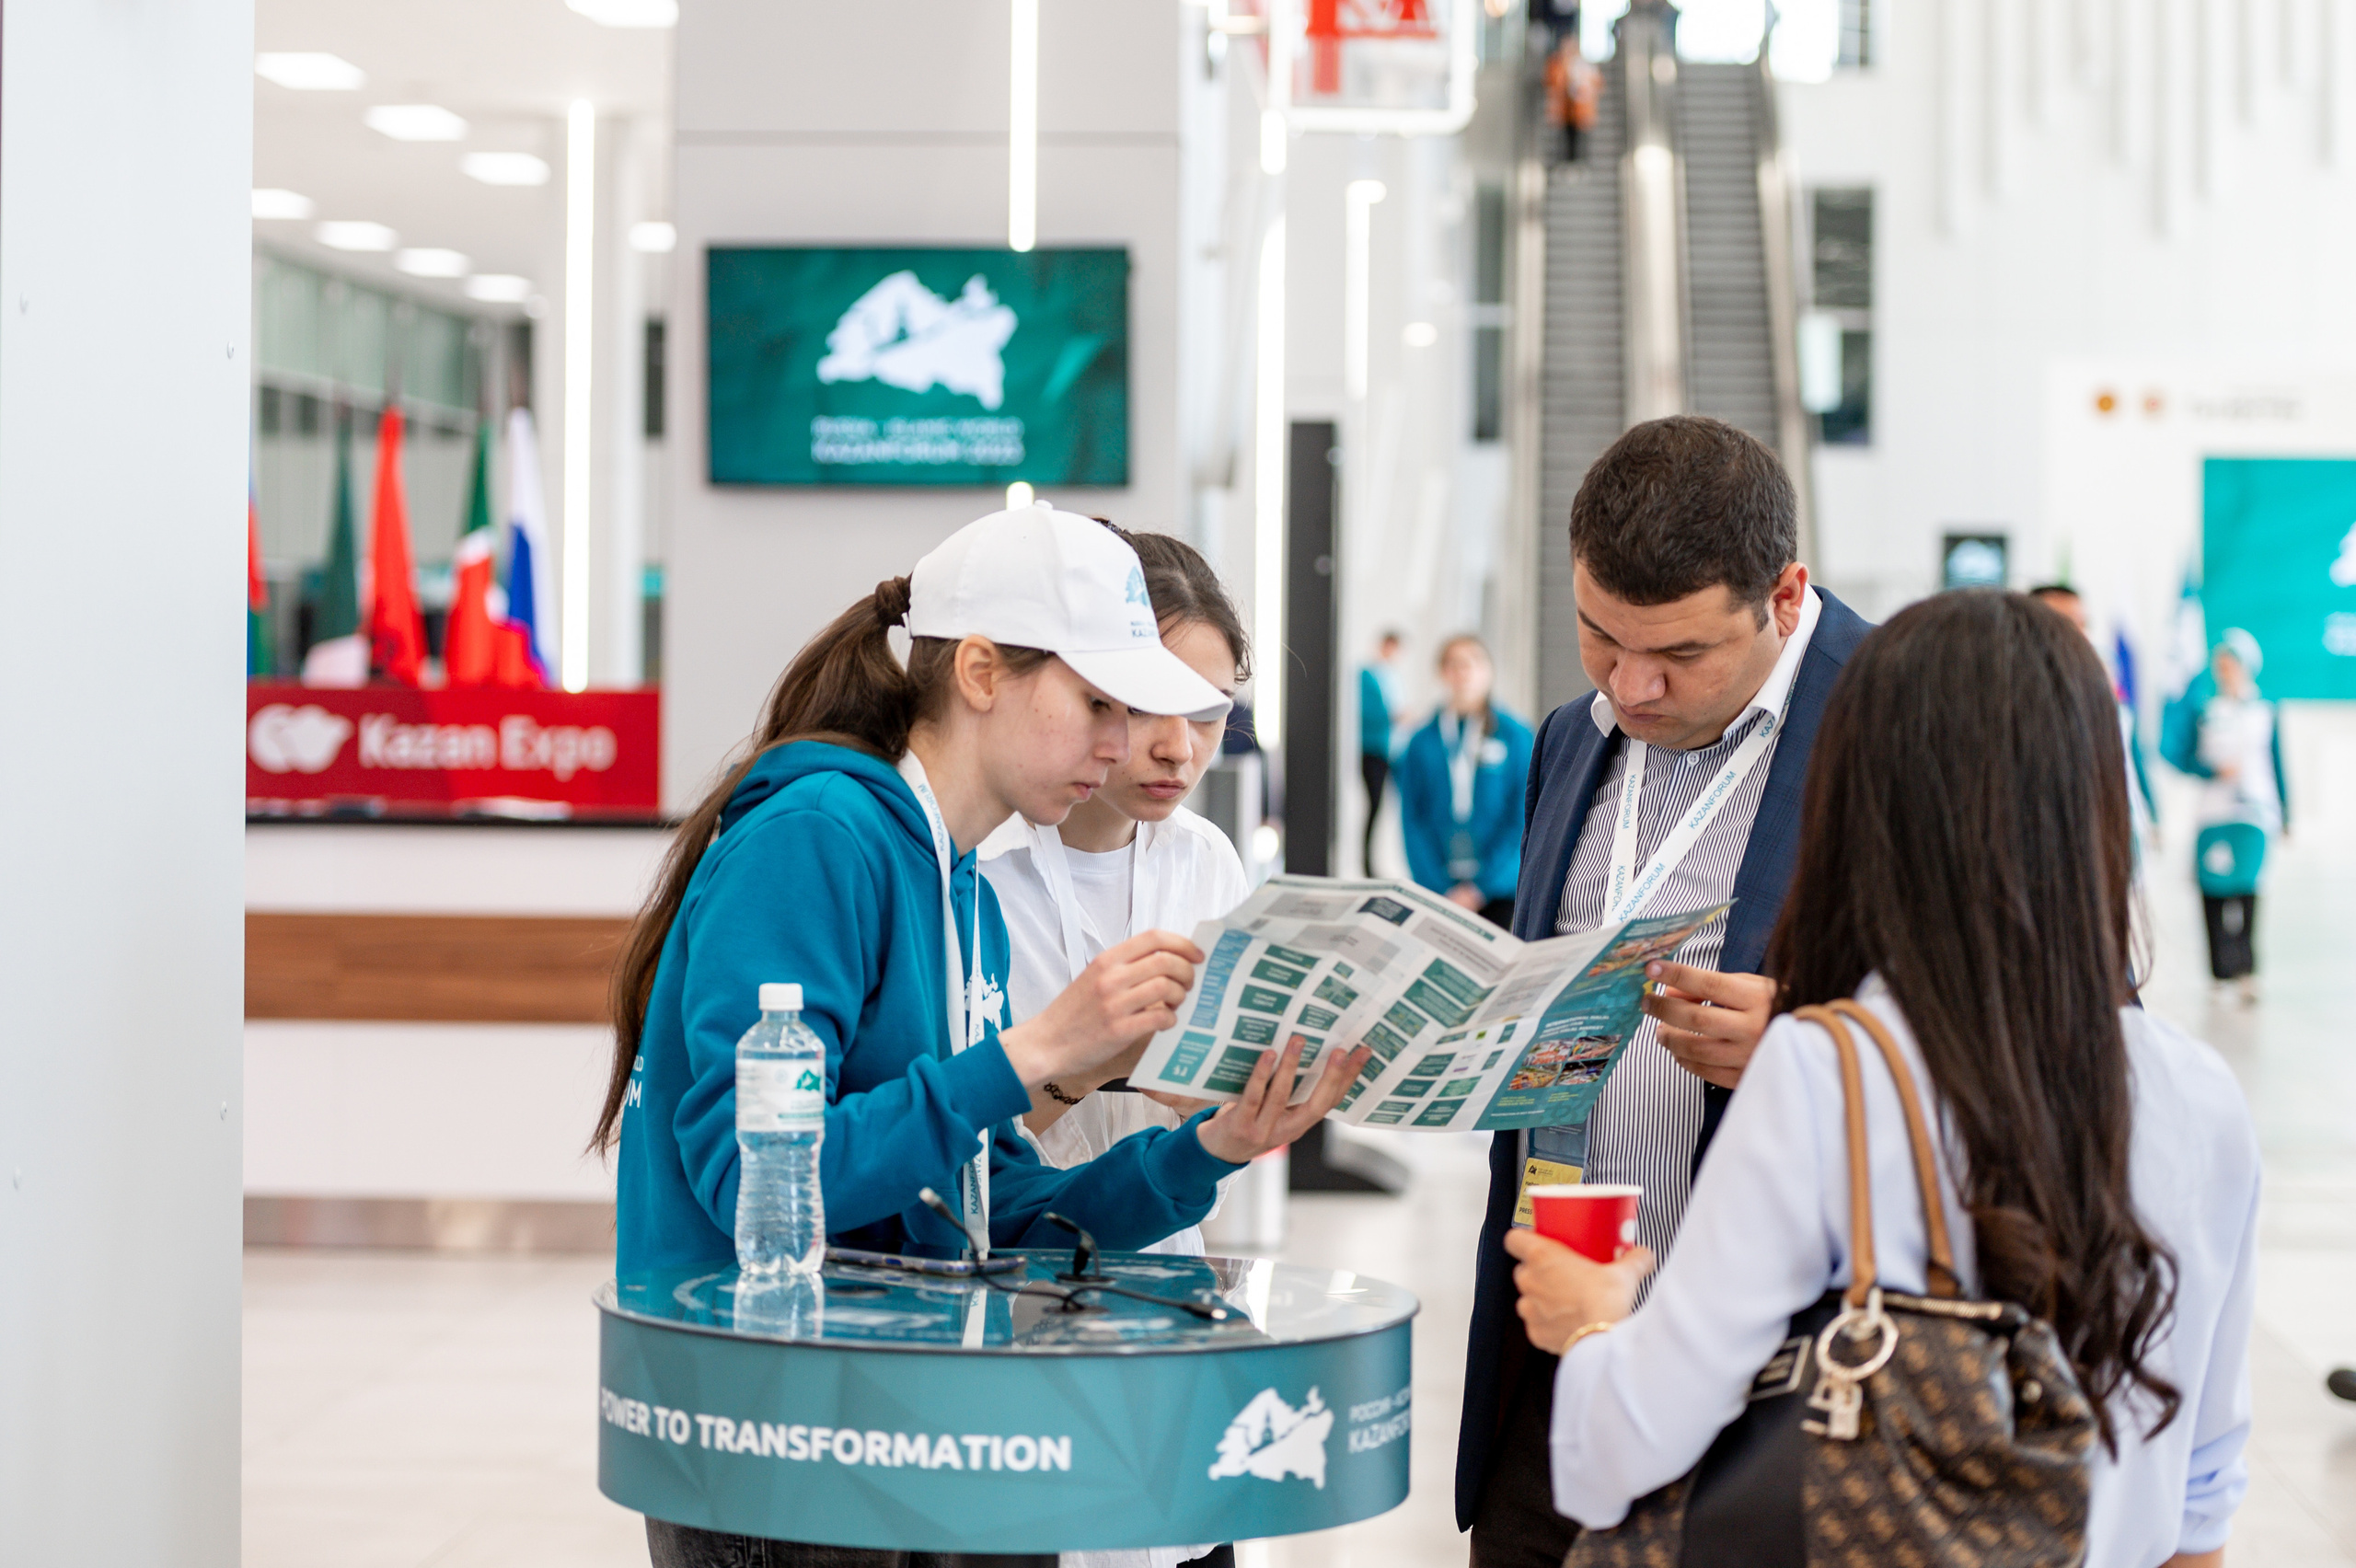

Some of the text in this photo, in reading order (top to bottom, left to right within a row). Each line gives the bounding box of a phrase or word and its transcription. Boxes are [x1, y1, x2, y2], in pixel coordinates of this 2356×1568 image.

[358, 713, 617, 782] Kazan Expo
[1623, 773, 1636, 830] KAZANFORUM
[1688, 770, 1738, 831] KAZANFORUM
[1617, 862, 1667, 923] KAZANFORUM
[1519, 1206, 1533, 1216] PRESS
[653, 1405, 690, 1446] TO
[695, 1413, 1072, 1472] TRANSFORMATION
